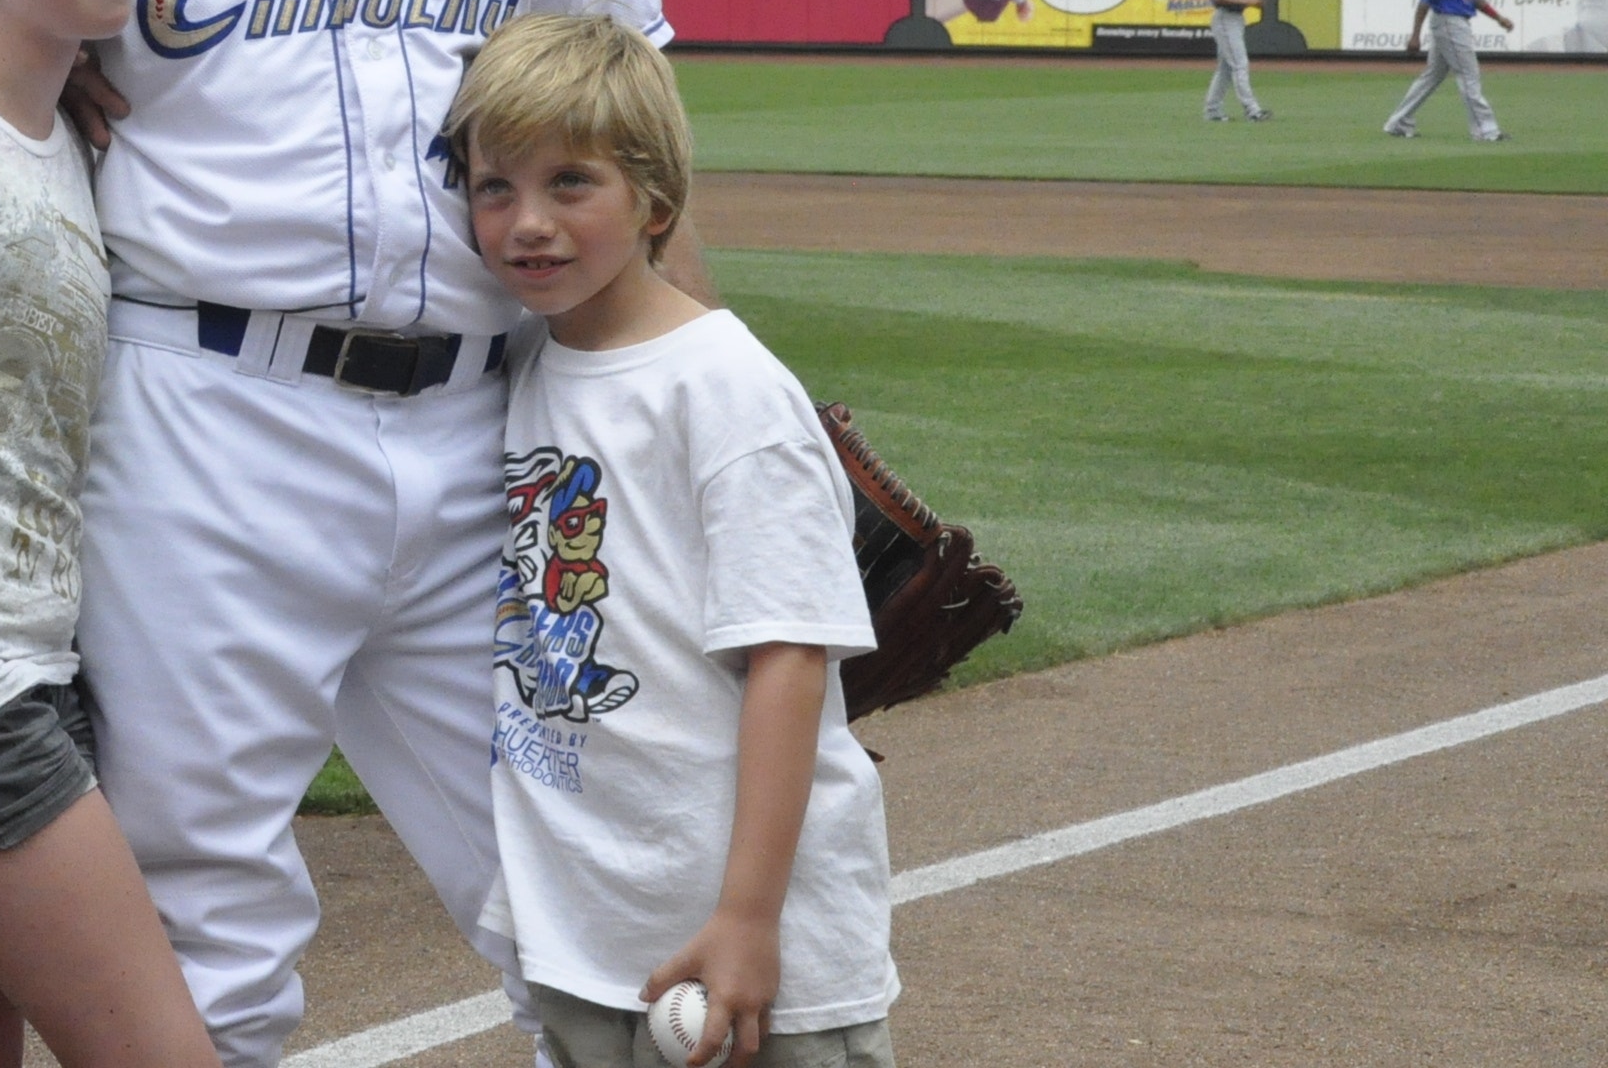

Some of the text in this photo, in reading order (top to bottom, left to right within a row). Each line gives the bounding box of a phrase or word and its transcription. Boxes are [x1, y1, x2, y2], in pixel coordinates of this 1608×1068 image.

[1353, 33, 1410, 48] PROU
[497, 701, 588, 748] PRESNTED BY
[497, 746, 584, 794] THODONTICS
